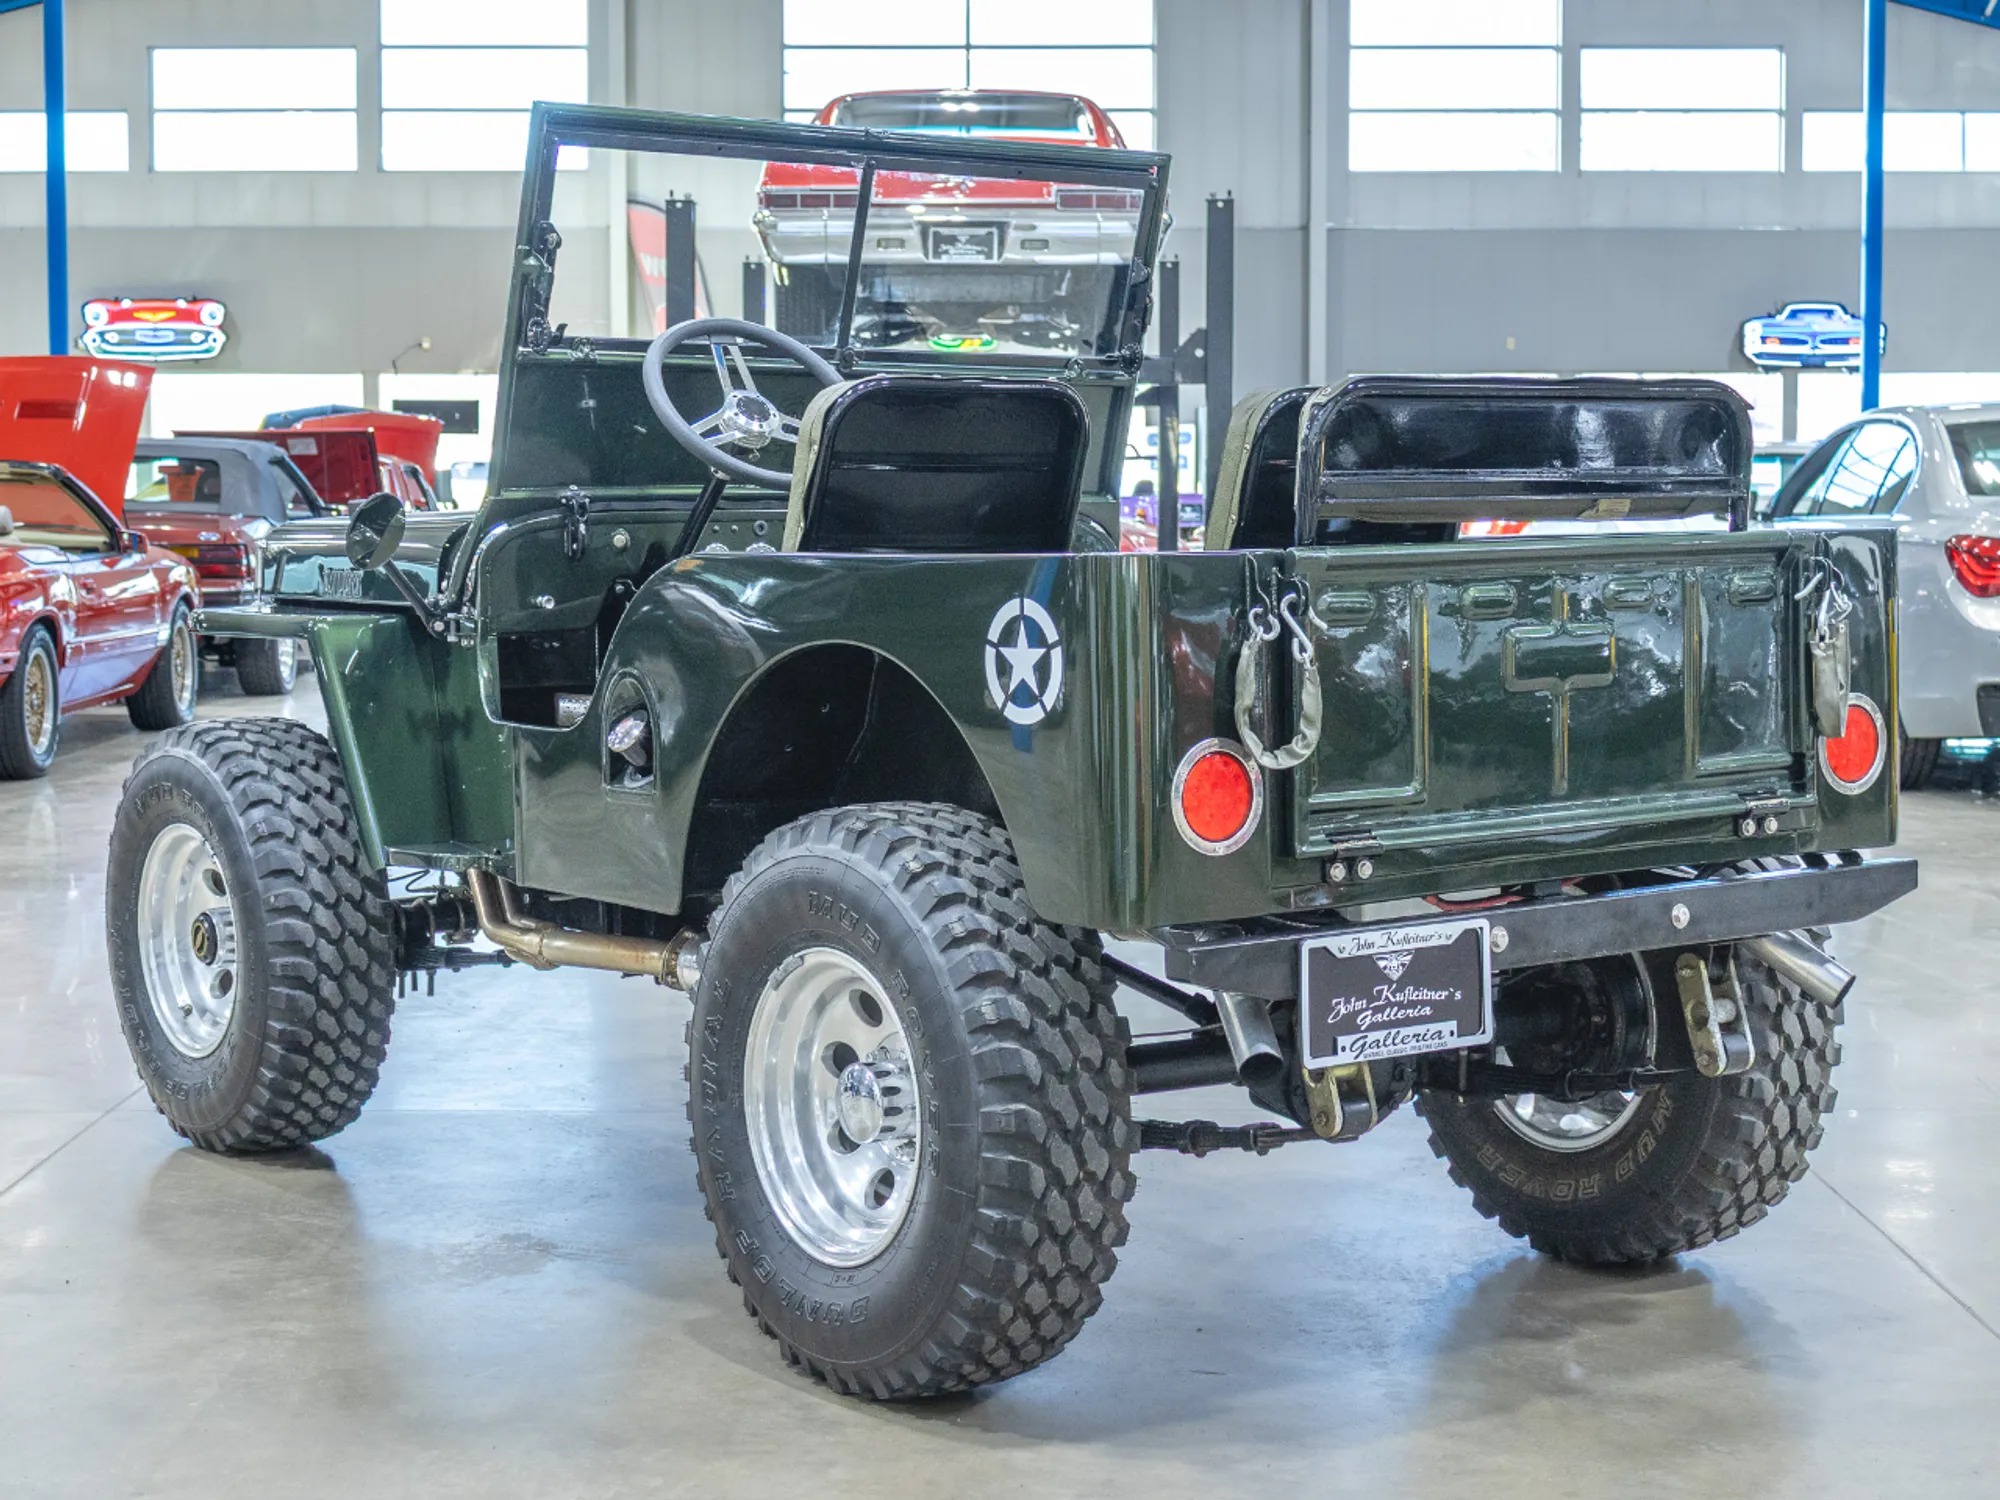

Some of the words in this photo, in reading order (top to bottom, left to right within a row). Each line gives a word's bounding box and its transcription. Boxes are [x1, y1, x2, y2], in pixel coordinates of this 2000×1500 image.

[808, 890, 881, 954] MUD
[1349, 937, 1375, 956] John
[1327, 997, 1367, 1024] John
[1356, 1005, 1433, 1030] Galleria
[1349, 1026, 1445, 1060] Galleria
[1615, 1089, 1673, 1182] MUD
[1477, 1144, 1601, 1200] ROVER
[735, 1229, 870, 1326] DUNLOP
